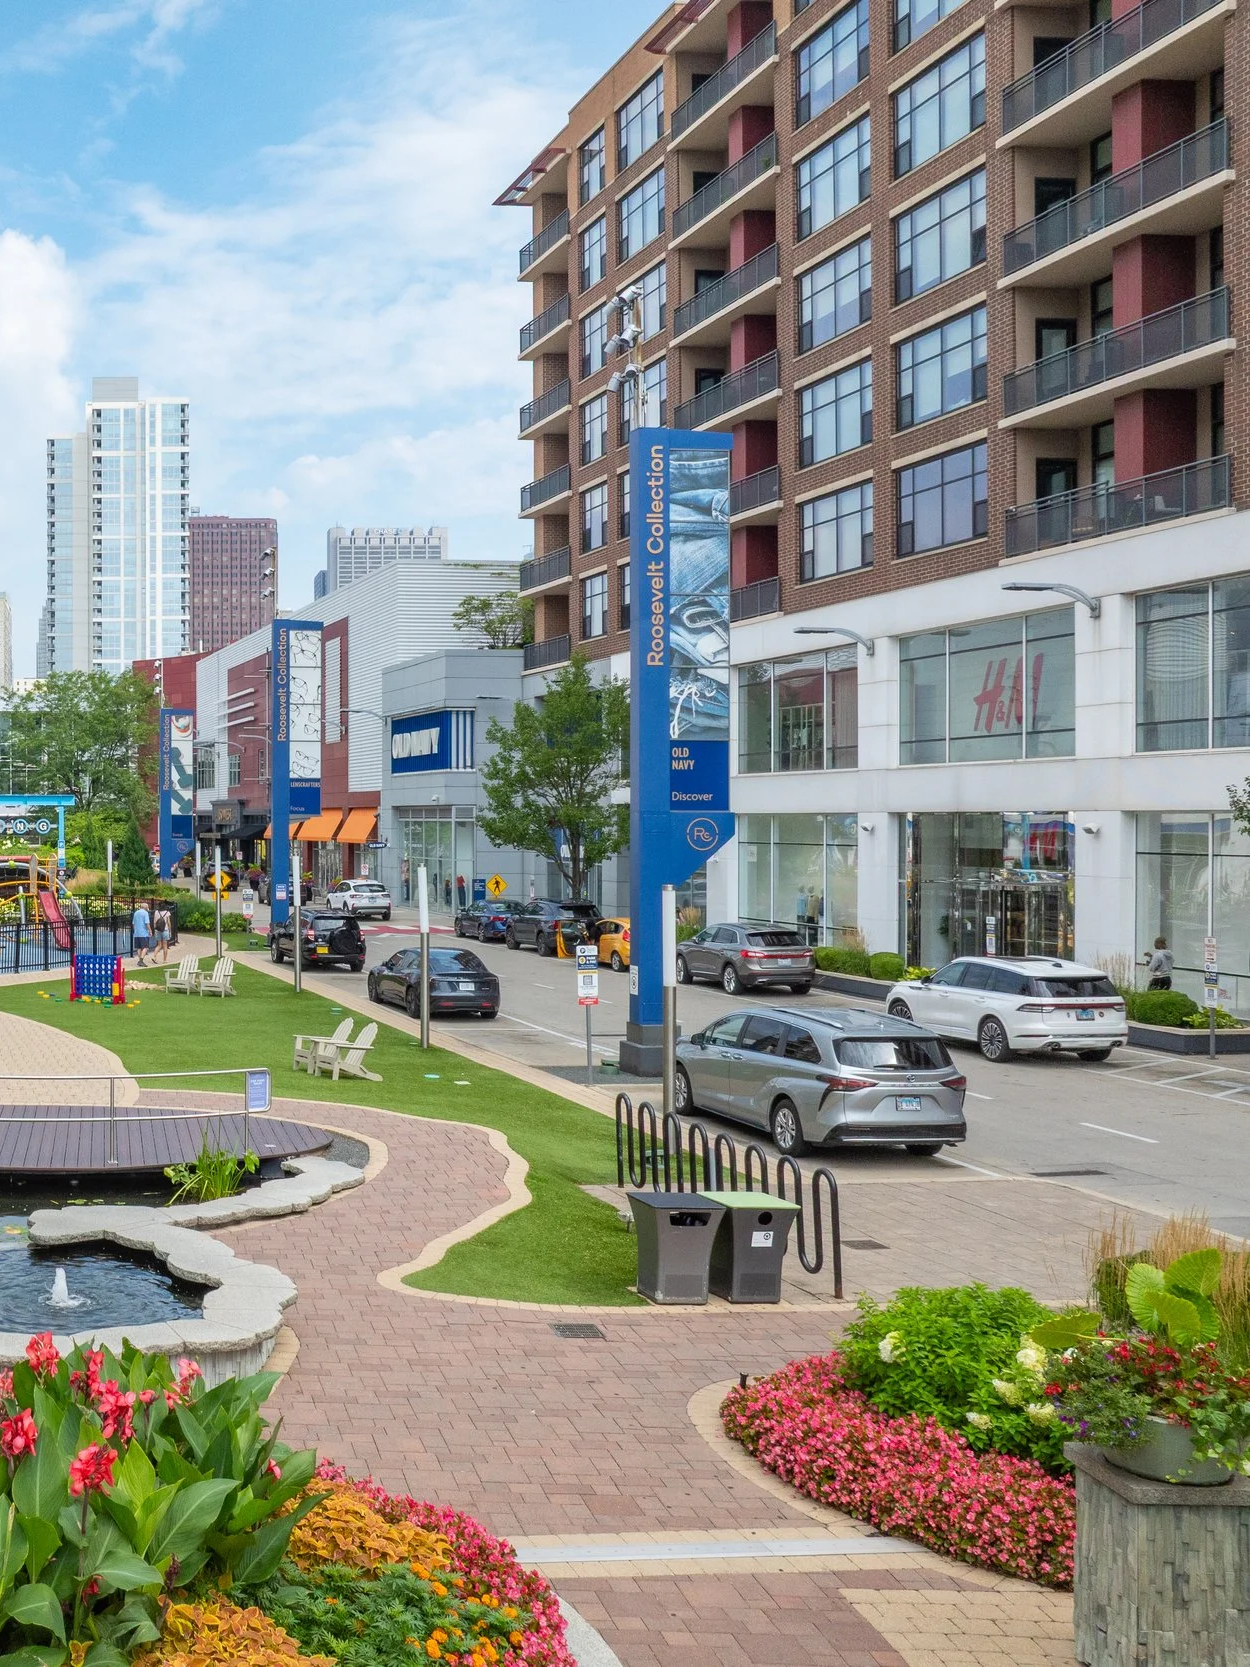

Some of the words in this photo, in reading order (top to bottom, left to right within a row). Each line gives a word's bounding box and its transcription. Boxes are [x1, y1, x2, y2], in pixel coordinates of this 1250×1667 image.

[646, 445, 664, 555] Collection
[647, 561, 664, 666] Roosevelt
[277, 628, 287, 684] Collection
[277, 687, 287, 742] Roosevelt
[973, 653, 1044, 734] H&M
[392, 733, 410, 759] OLD
[411, 727, 440, 757] NAVY
[672, 747, 689, 757] OLD
[672, 760, 695, 770] NAVY
[672, 791, 713, 801] Discover
